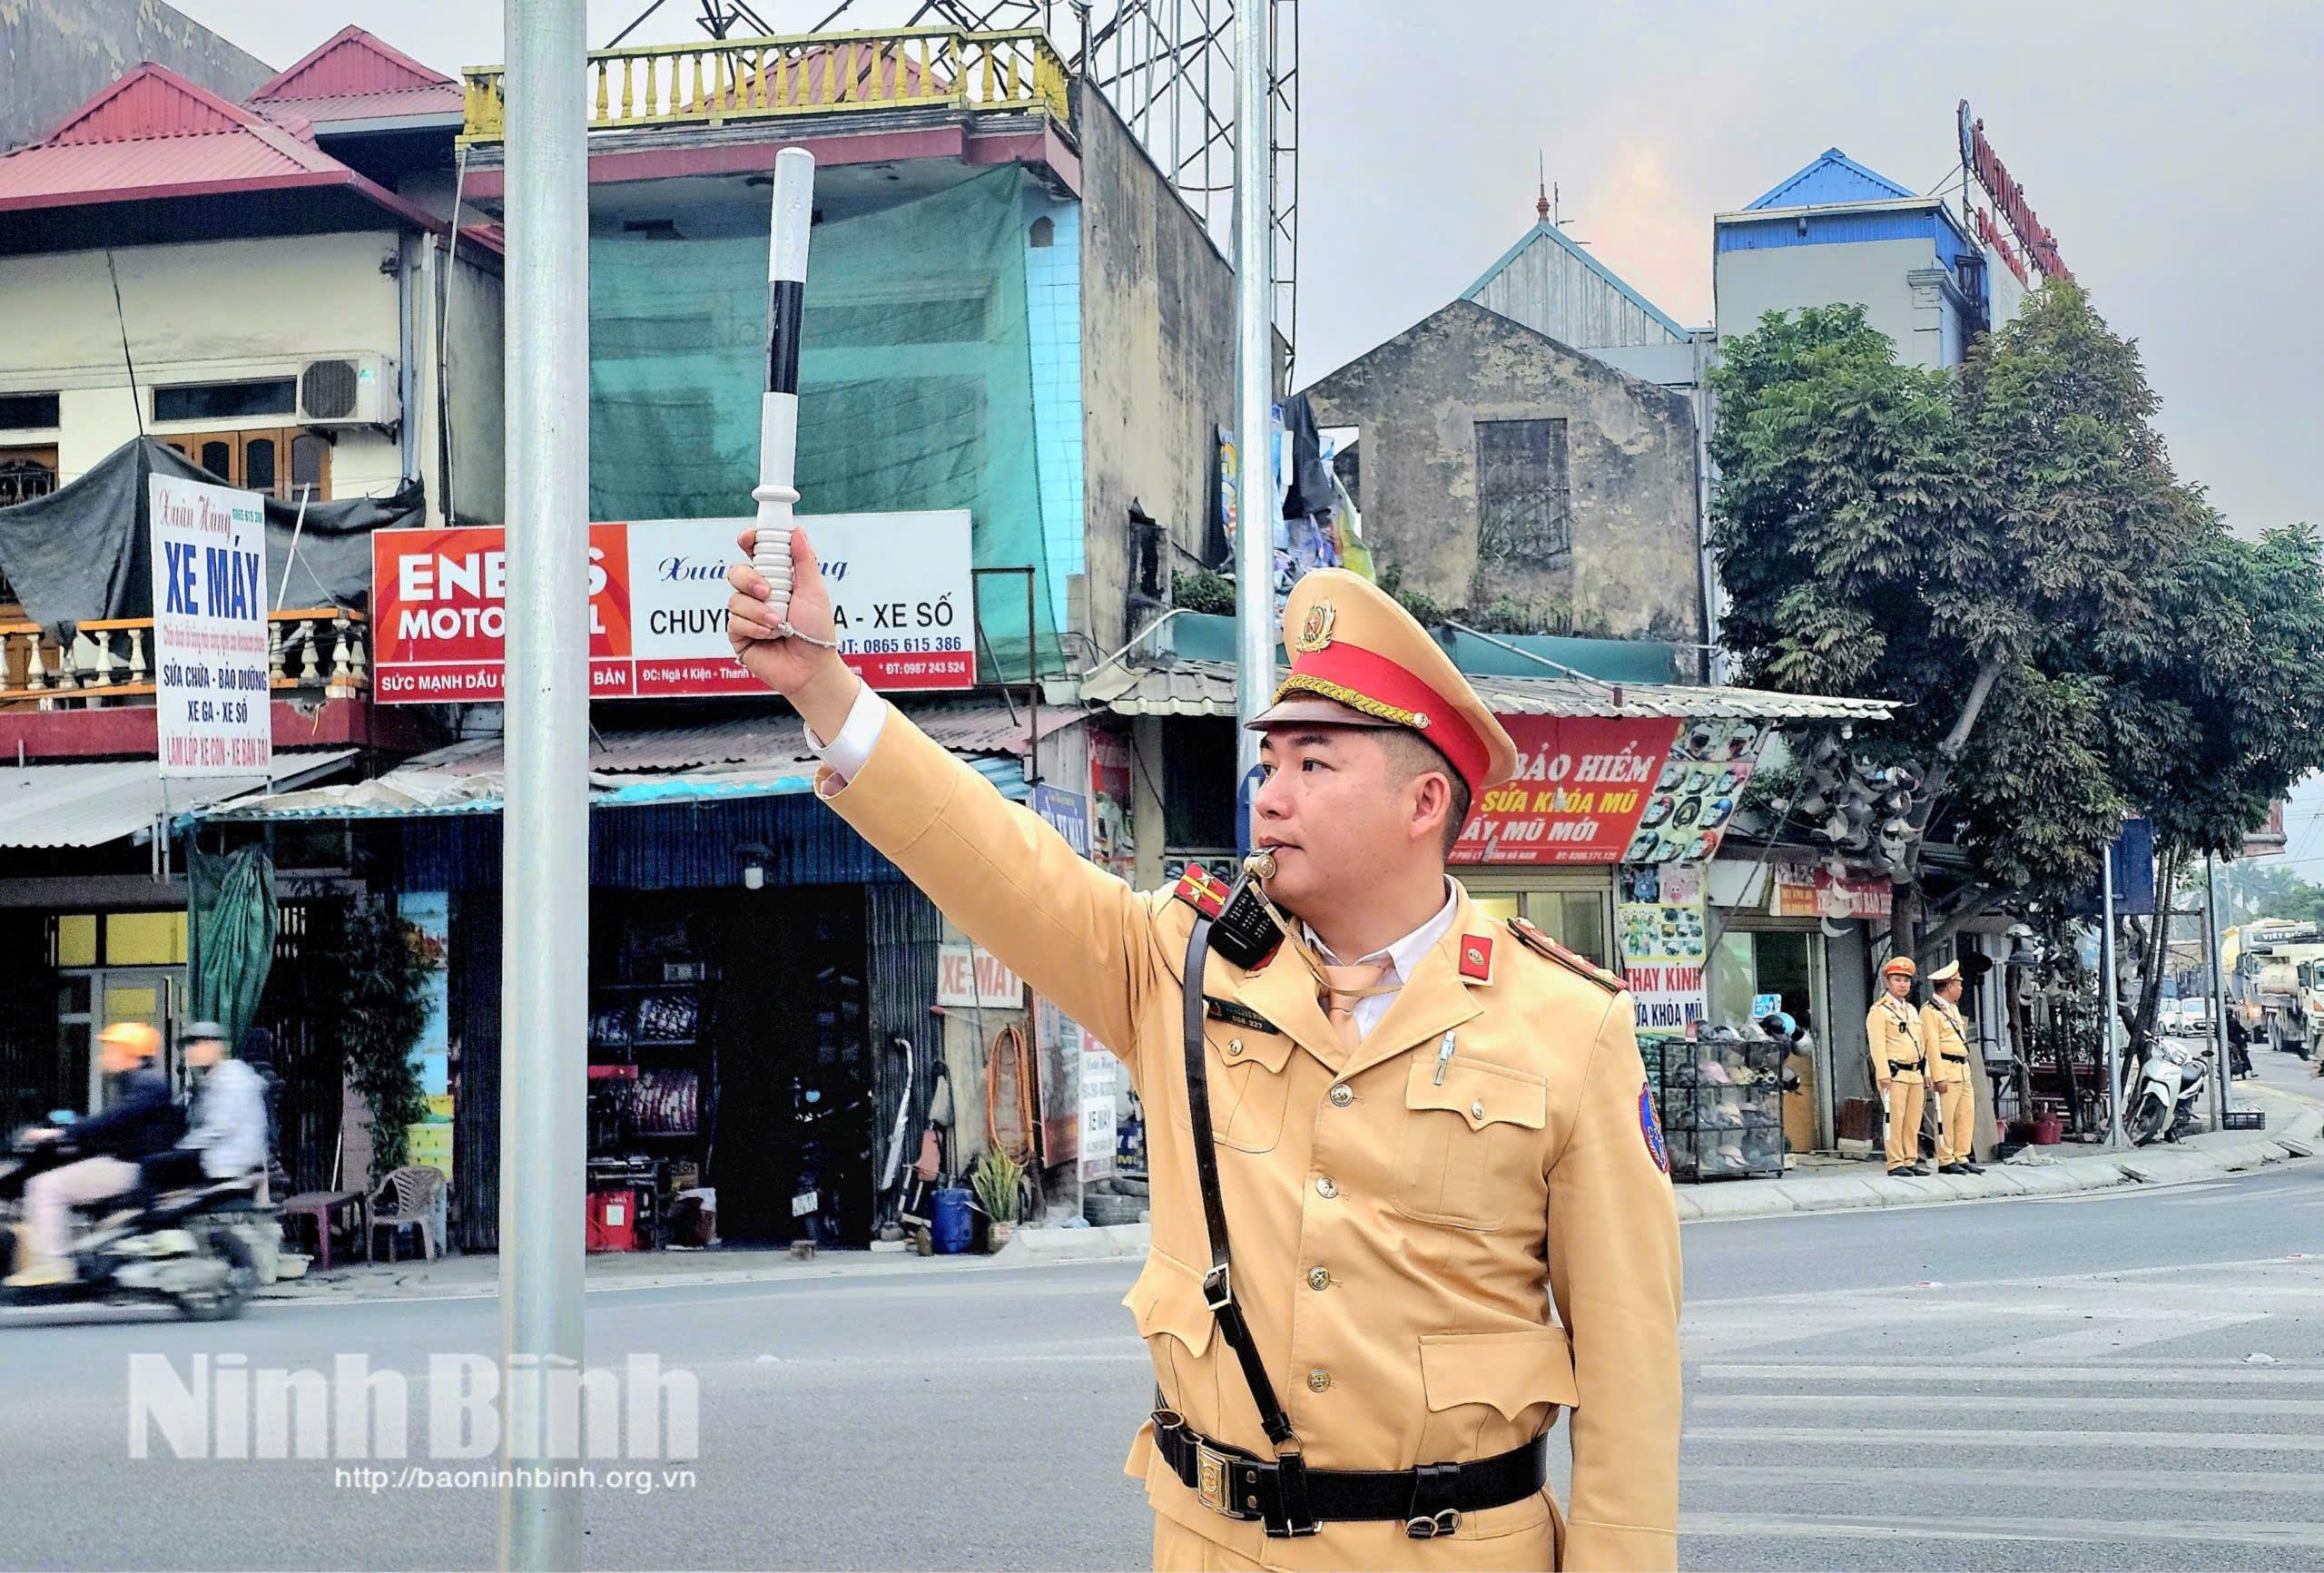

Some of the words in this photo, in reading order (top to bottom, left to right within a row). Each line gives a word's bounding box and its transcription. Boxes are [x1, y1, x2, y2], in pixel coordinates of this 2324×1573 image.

[164, 541, 198, 615] XE
[206, 535, 259, 621] MÁY
[399, 547, 607, 602] ENES
[658, 556, 726, 582] Xuâ
[399, 606, 505, 640] MOTO
[650, 608, 729, 634] CHUY
[873, 603, 907, 629] XE
[917, 592, 953, 627] SỐ
[863, 639, 899, 653] 0865
[903, 638, 931, 652] 615
[935, 636, 962, 651] 386
[163, 657, 182, 688] SỬA
[185, 663, 210, 689] CHỮA
[219, 661, 236, 689] BẢO
[239, 665, 267, 692] DƯỠNG
[381, 670, 415, 691] SỨC
[419, 674, 462, 693] MẠNH
[466, 668, 497, 689] DẦU
[594, 666, 625, 685] BẢN
[929, 662, 945, 673] 243
[947, 661, 966, 673] 524
[188, 700, 199, 723] XE
[202, 701, 213, 723] GA
[222, 702, 232, 723] XE
[236, 695, 248, 723] SỐ
[1511, 742, 1571, 782] BẢO
[1574, 740, 1656, 783] HIỂM
[1481, 782, 1529, 812] SỬA
[1598, 789, 1639, 813] MŨ
[1457, 813, 1500, 841] ẤY
[1501, 818, 1546, 841] MŨ
[1547, 816, 1599, 842] MỚI
[942, 955, 968, 995] XE
[1627, 967, 1660, 991] THAY
[1667, 962, 1702, 991] KÍNH
[1634, 996, 1649, 1027] ỬA
[1652, 998, 1681, 1027] KHÓA
[1685, 998, 1703, 1026] MŨ
